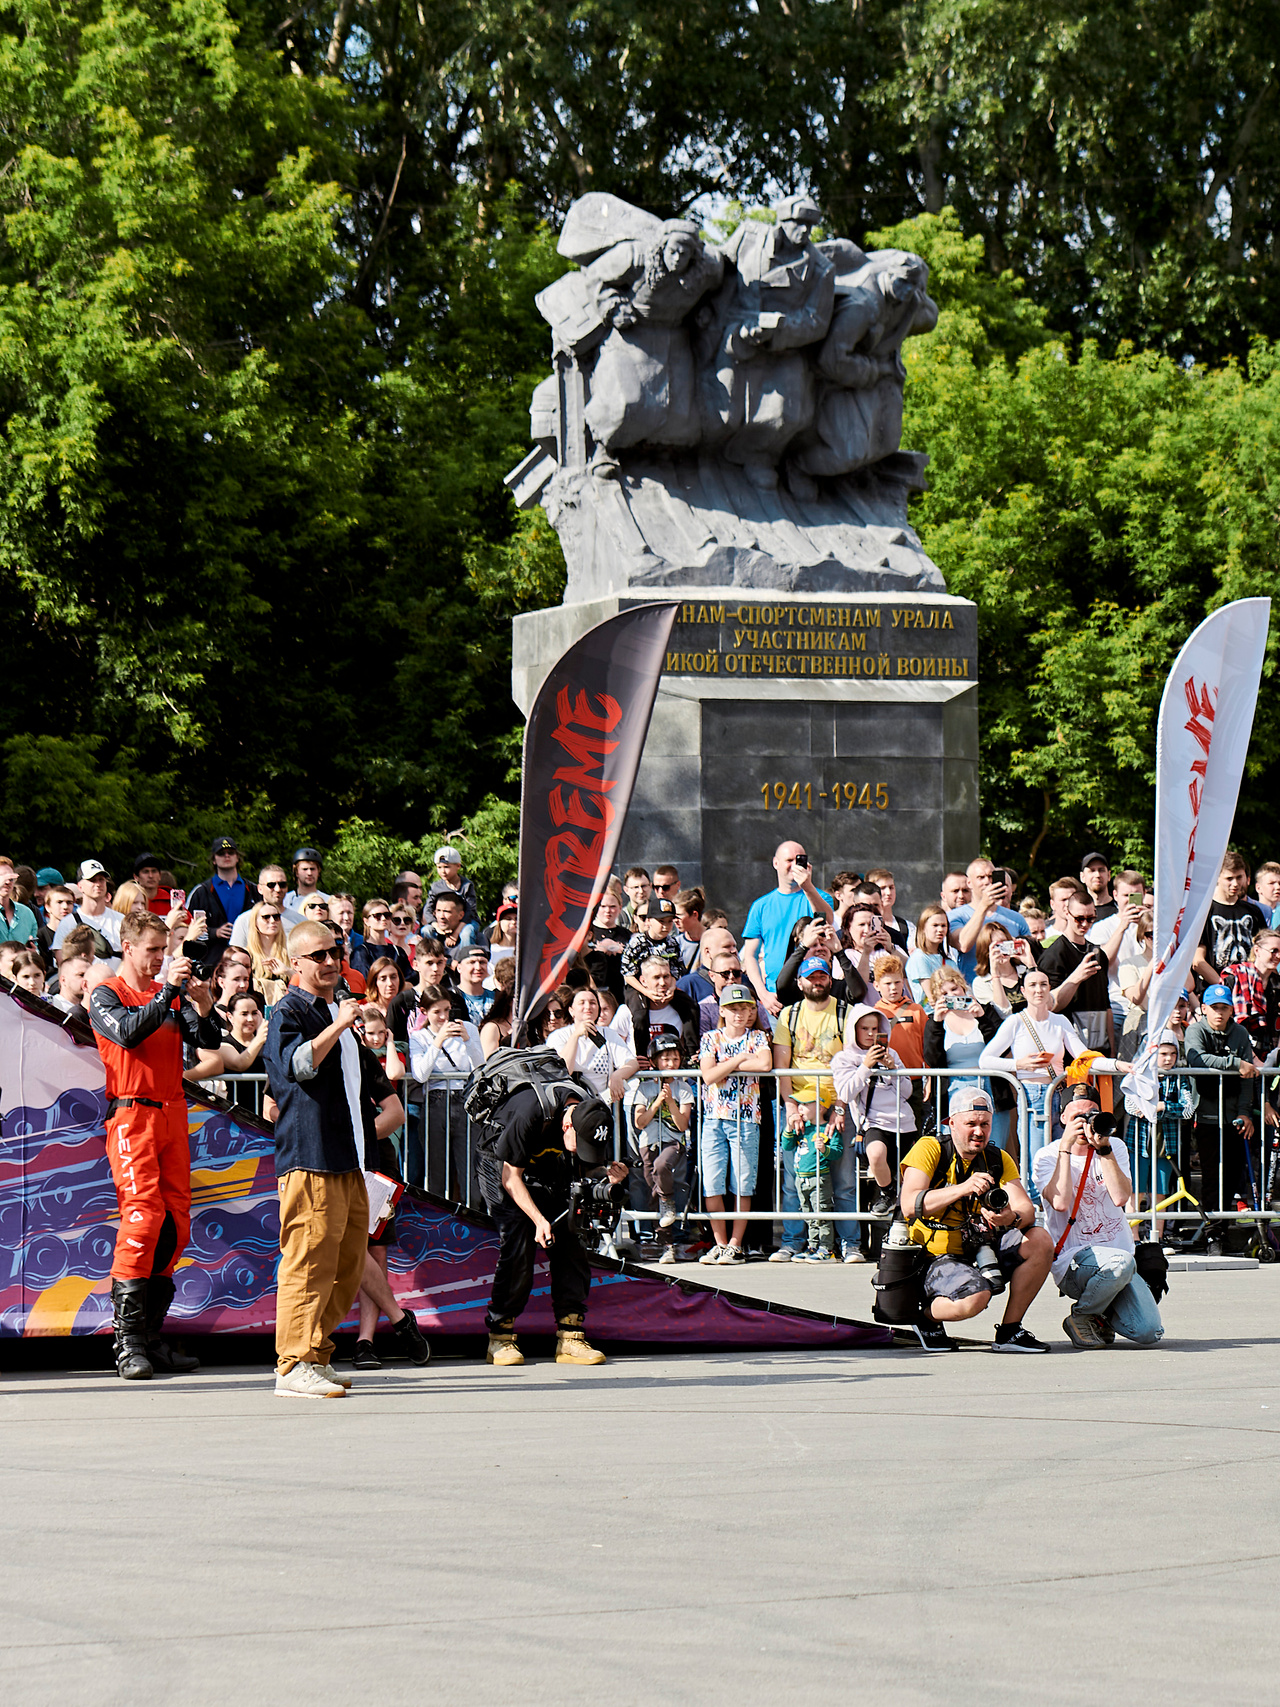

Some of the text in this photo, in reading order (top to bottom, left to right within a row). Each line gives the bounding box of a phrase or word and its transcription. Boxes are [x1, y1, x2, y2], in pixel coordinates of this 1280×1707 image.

[677, 604, 954, 629] НАМ-СПОРТСМЕНАМ УРАЛА
[733, 629, 866, 650] УЧАСТНИКАМ
[664, 649, 719, 673] ИКОЙ
[725, 652, 891, 675] ОТЕЧЕСТВЕННОЙ
[761, 781, 889, 810] 1941-1945
[117, 1123, 138, 1195] LEATT
